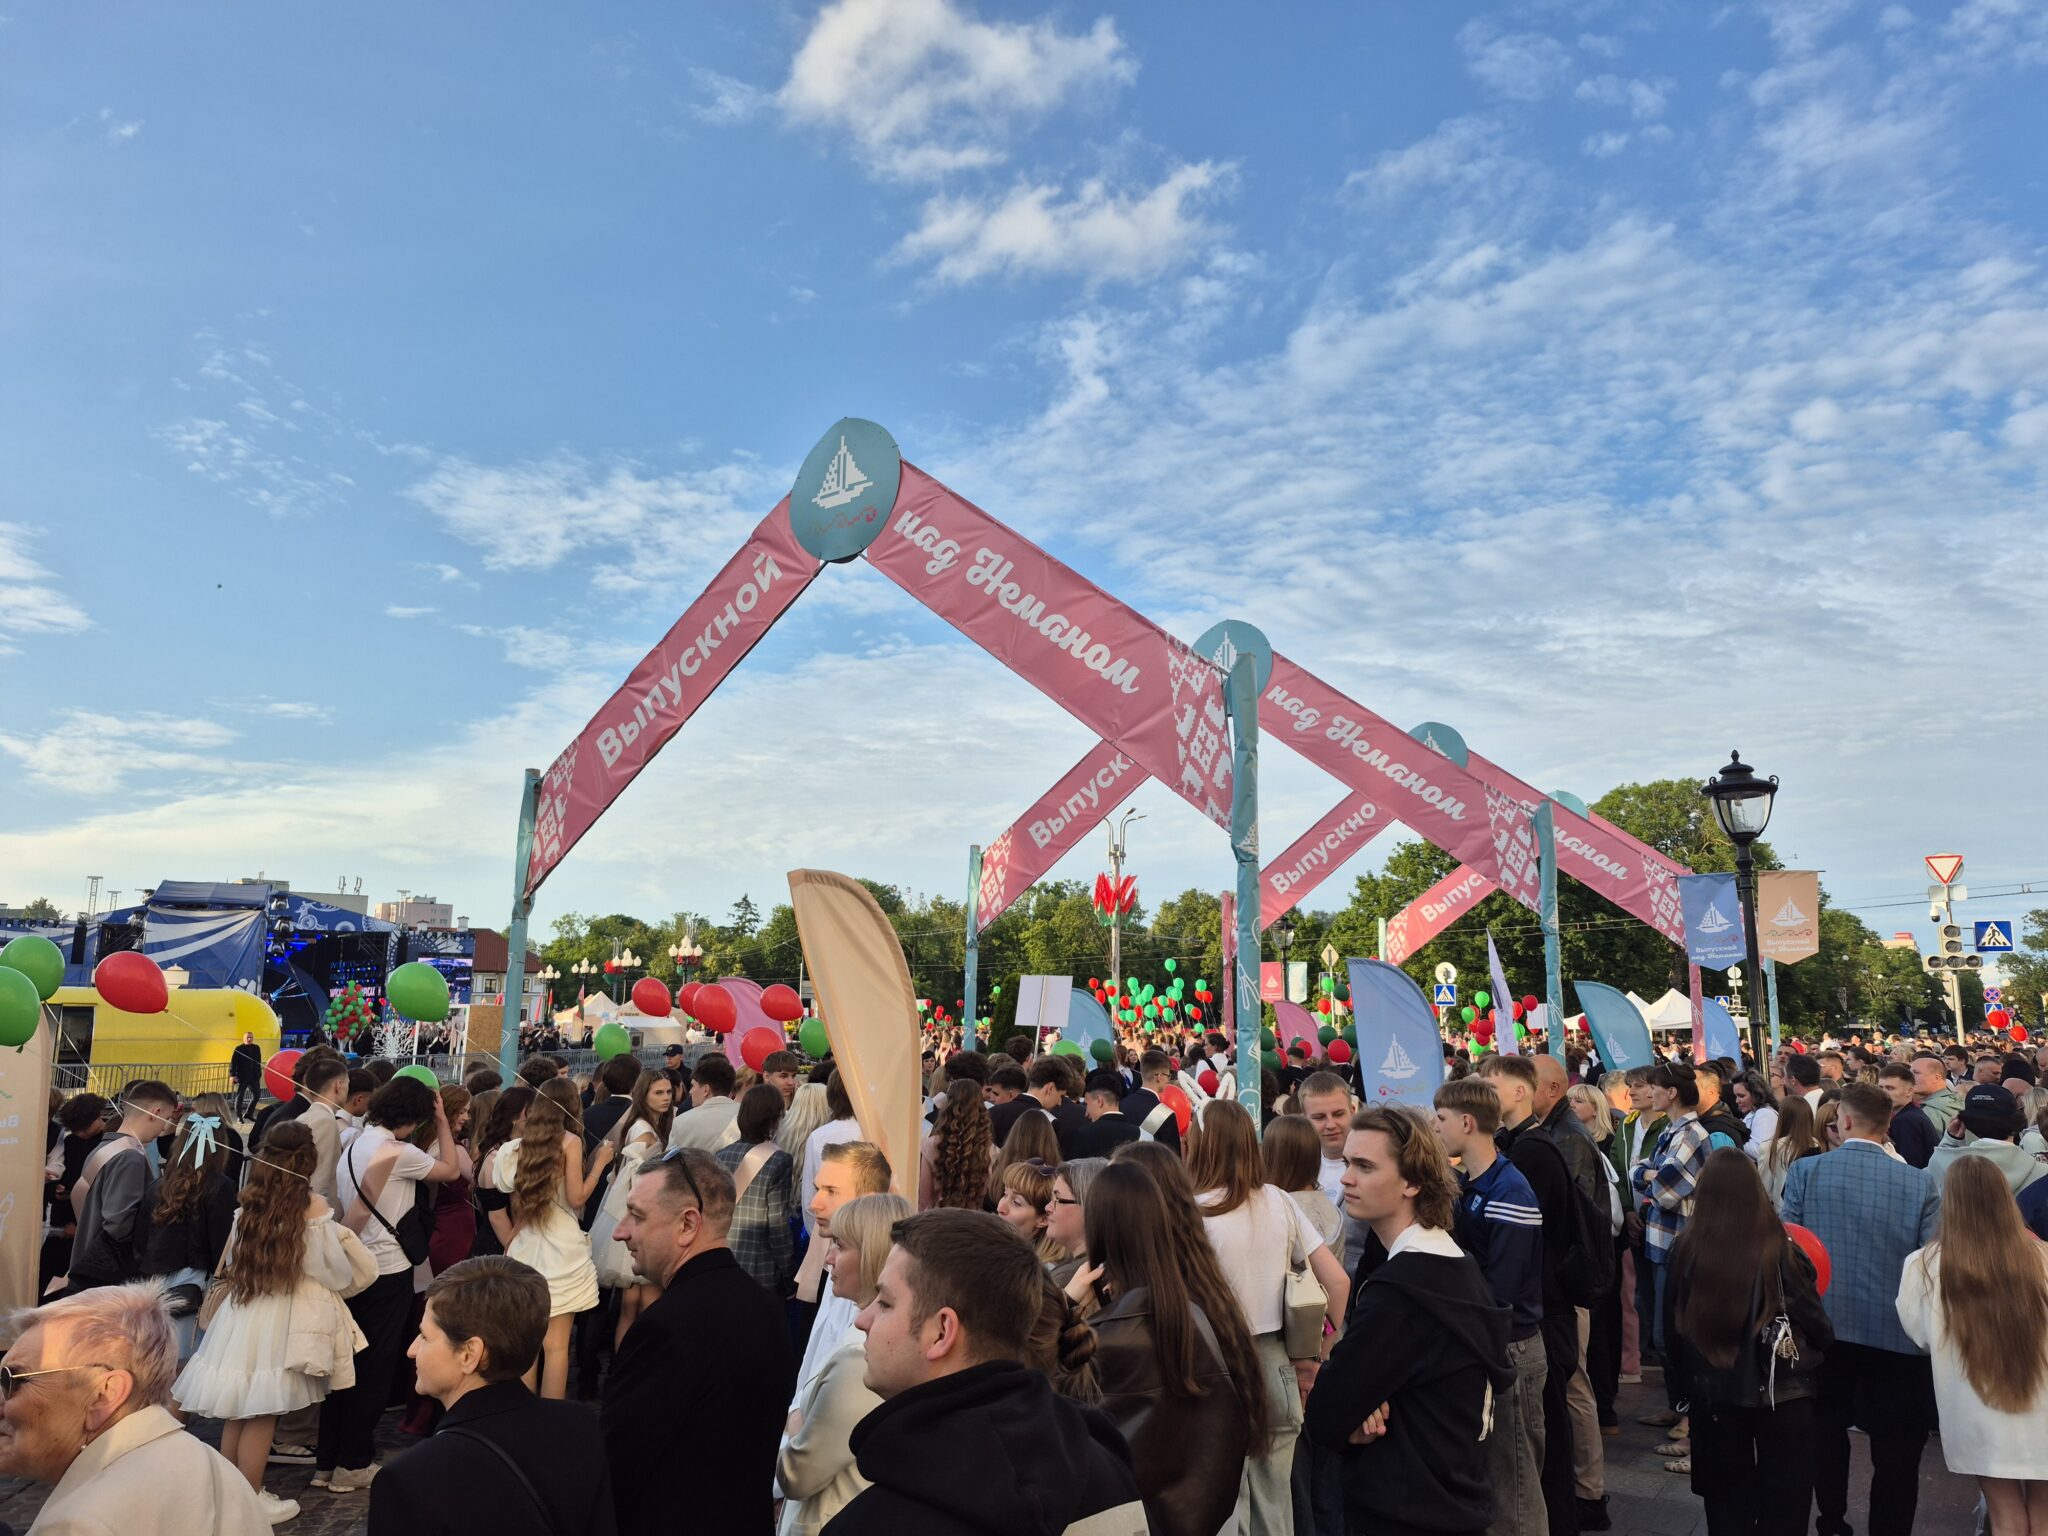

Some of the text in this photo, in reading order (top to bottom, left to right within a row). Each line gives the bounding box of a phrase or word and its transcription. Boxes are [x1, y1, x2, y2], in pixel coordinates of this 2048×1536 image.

[596, 552, 783, 768] Выпускной
[893, 510, 1140, 694] над Неманом
[1028, 752, 1135, 849] Выпуск
[1266, 685, 1466, 820] над Неманом
[1270, 802, 1382, 895] Выпускно
[1419, 873, 1487, 923] Выпус
